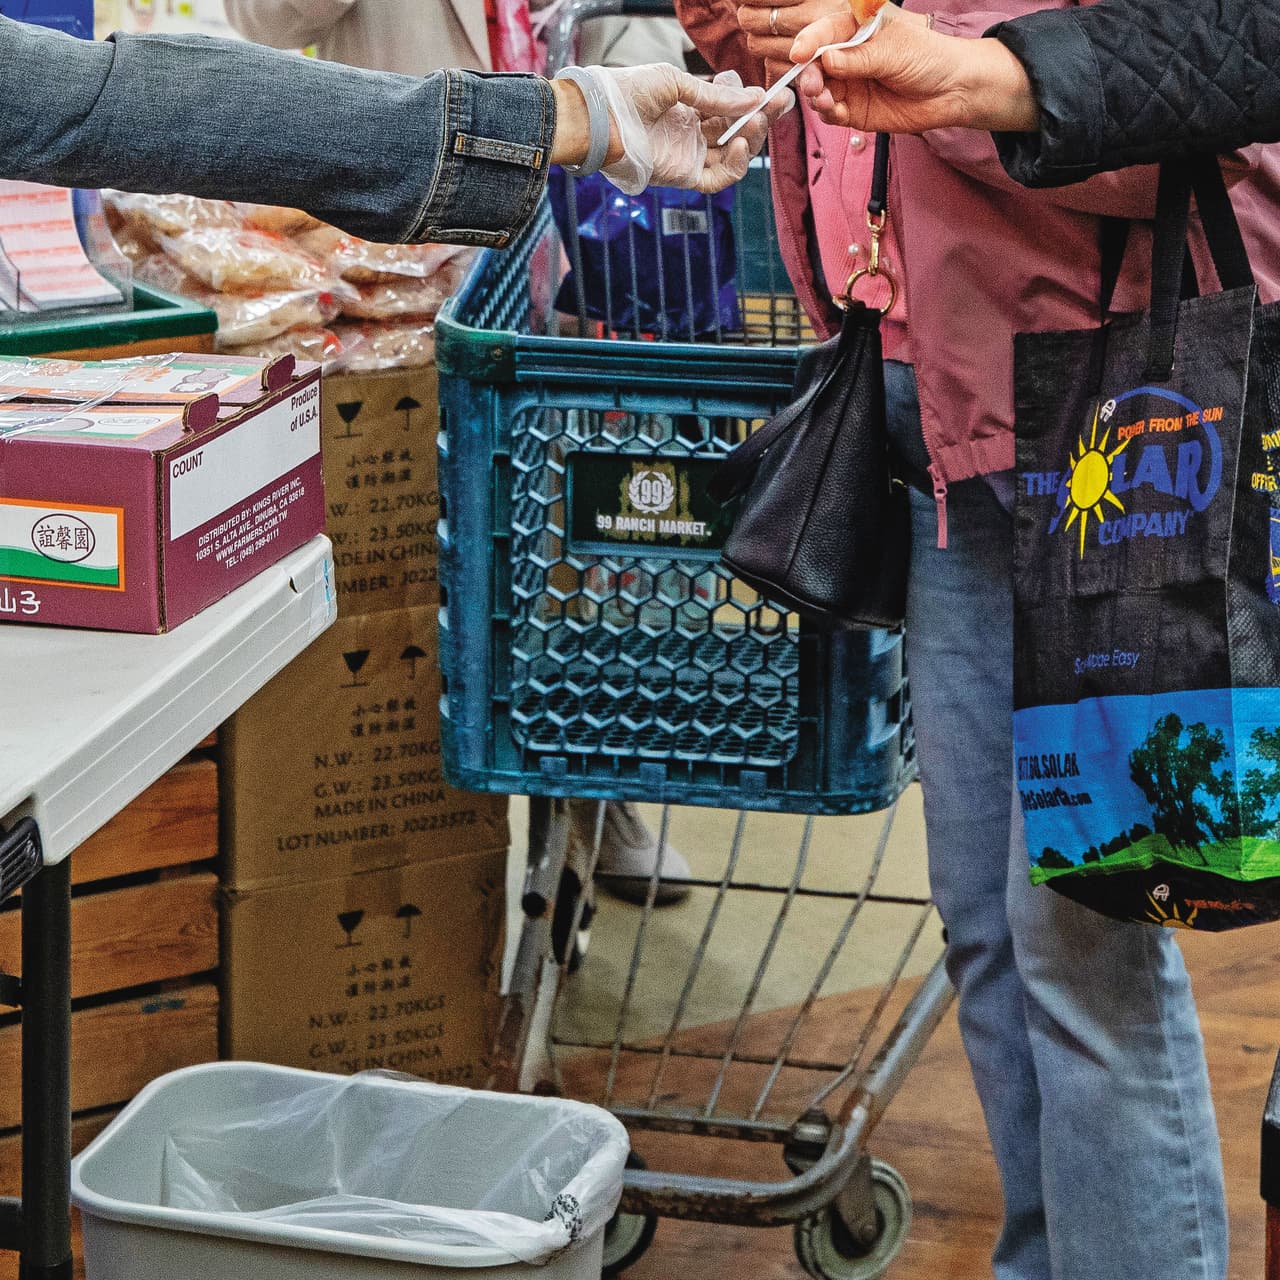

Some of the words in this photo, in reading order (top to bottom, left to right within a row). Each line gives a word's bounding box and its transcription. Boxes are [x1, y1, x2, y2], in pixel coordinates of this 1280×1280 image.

[291, 385, 318, 410] Produce
[290, 419, 298, 432] of
[299, 406, 319, 428] U.S.A.
[1149, 417, 1183, 433] FROM
[1186, 411, 1200, 428] THE
[1202, 406, 1224, 423] SUN
[172, 450, 204, 479] COUNT
[640, 478, 663, 505] 99
[1021, 470, 1061, 497] THE
[195, 545, 214, 562] 10351
[214, 540, 222, 551] S.
[222, 531, 237, 546] ALTA
[255, 506, 279, 528] DINUBA,
[279, 498, 288, 510] CA
[288, 487, 305, 505] 93618
[198, 514, 240, 548] DISTRIBUTED
[241, 508, 251, 521] BY:
[252, 496, 271, 513] KINGS
[271, 485, 290, 502] RIVER
[290, 477, 302, 492] INC.
[596, 514, 612, 529] 99
[615, 516, 656, 533] RANCH
[215, 510, 288, 563] WWW.FARMERS.COM.TW
[1097, 510, 1190, 546] COMPANY
[224, 553, 239, 569] TEL:
[366, 548, 385, 565] IN
[389, 541, 438, 563] CHIN
[1111, 648, 1141, 669] Easy
[314, 799, 365, 820] MADE
[369, 795, 388, 814] IN
[391, 788, 446, 810] CHINA
[277, 833, 310, 853] LOT
[314, 823, 395, 847] NUMBER:
[387, 1045, 443, 1067] CHINA
